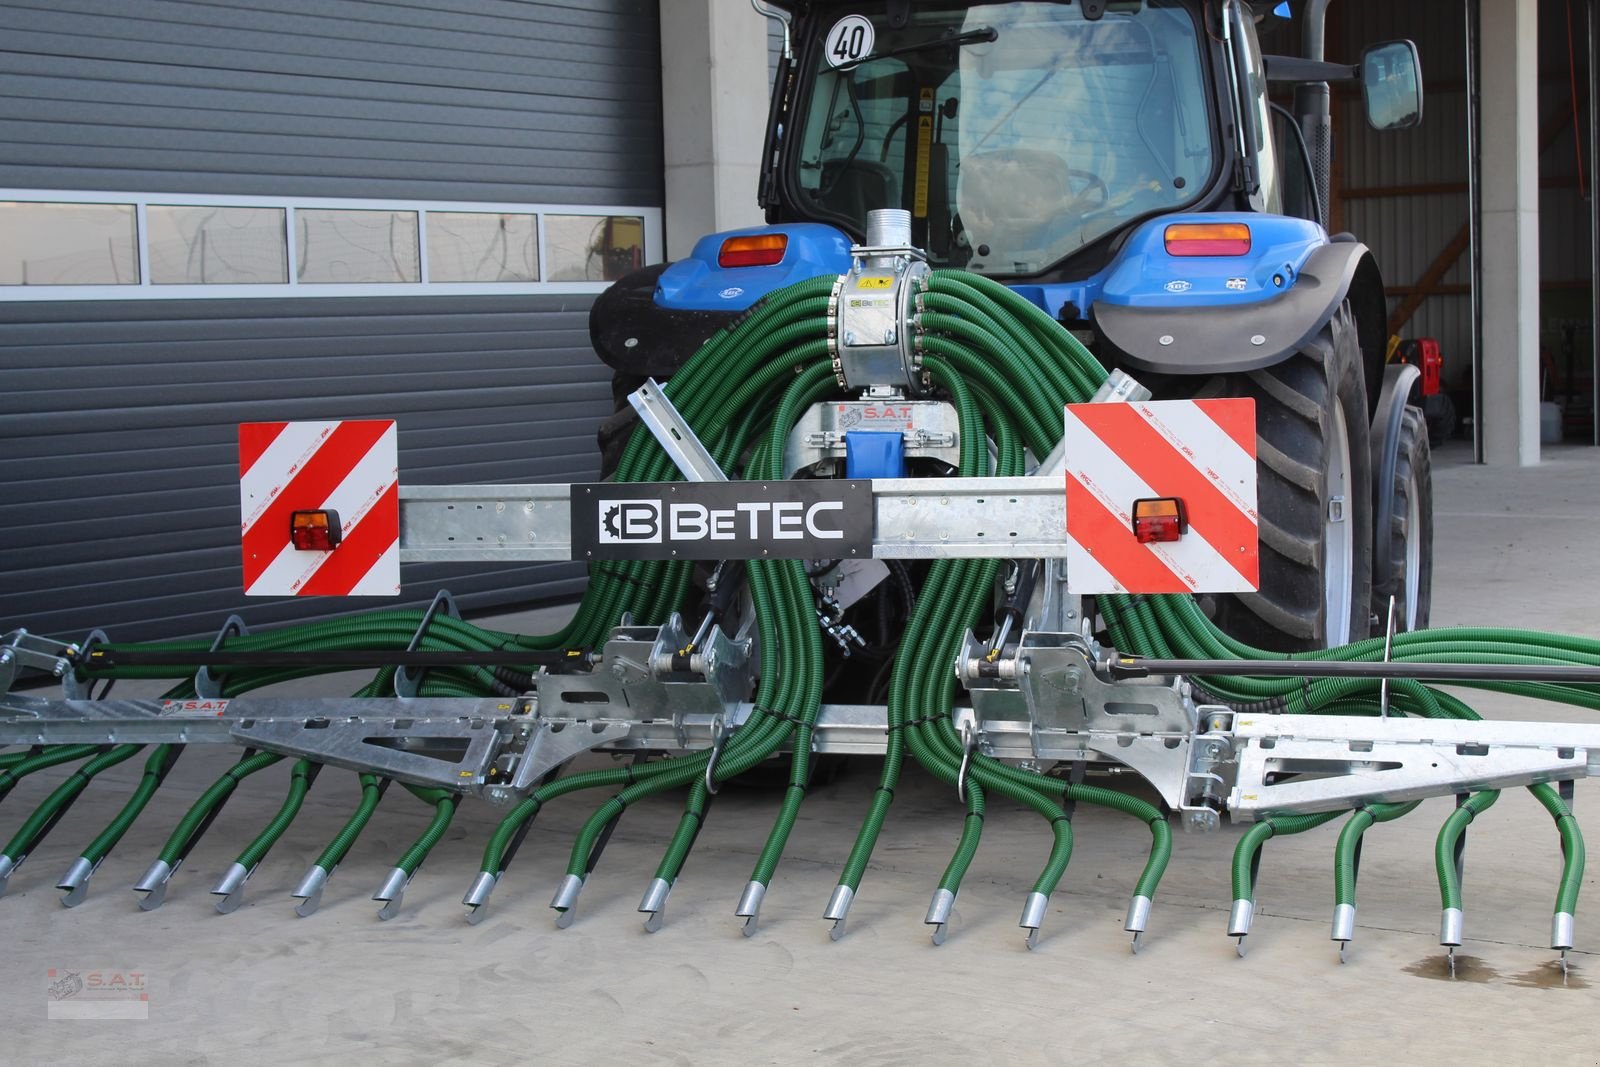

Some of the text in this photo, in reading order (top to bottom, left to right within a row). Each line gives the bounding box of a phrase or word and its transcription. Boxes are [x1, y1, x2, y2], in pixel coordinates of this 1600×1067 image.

[833, 26, 865, 60] 40
[863, 407, 912, 419] S.A.T.
[184, 701, 227, 709] S.A.T.
